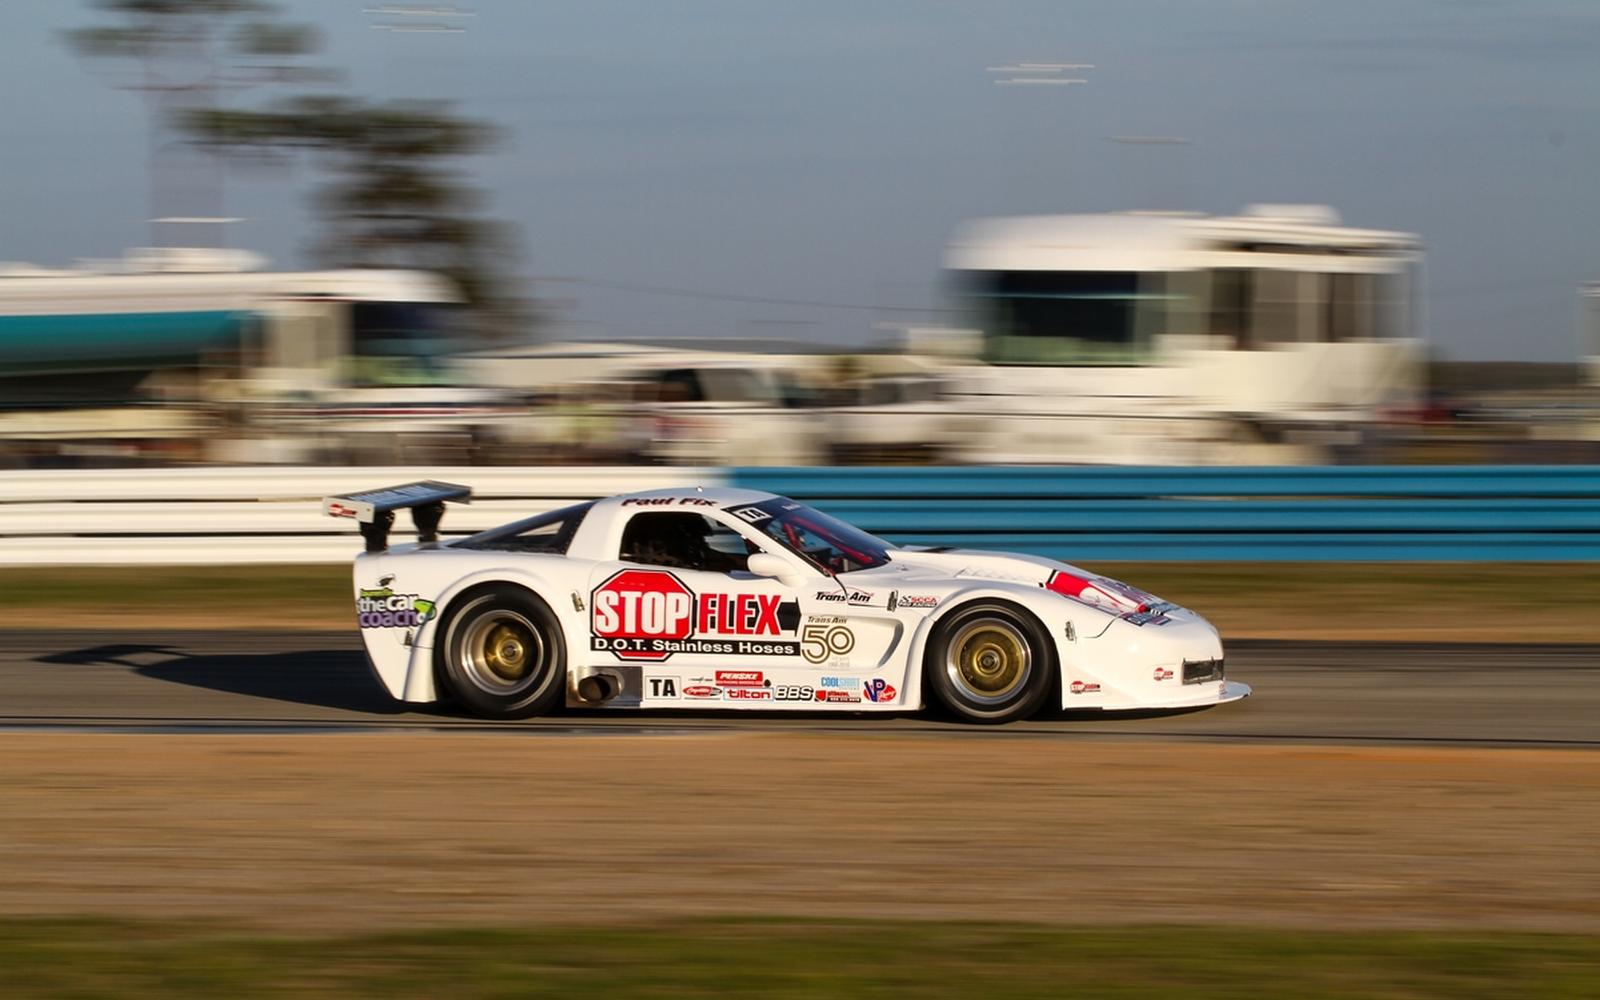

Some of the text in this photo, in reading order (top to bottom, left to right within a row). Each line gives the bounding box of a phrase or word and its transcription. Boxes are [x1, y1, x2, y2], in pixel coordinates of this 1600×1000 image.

[621, 498, 718, 506] Paul Fix
[739, 509, 766, 519] TA
[815, 591, 871, 602] Trans Am
[594, 590, 781, 636] STOP FLEX
[808, 616, 849, 625] Trans Am
[594, 639, 795, 654] D.O.T. Stainless Hoses
[801, 624, 855, 664] 50
[650, 679, 677, 696] TA
[727, 689, 771, 699] tilton
[775, 686, 814, 700] BBS
[863, 679, 886, 702] VP
